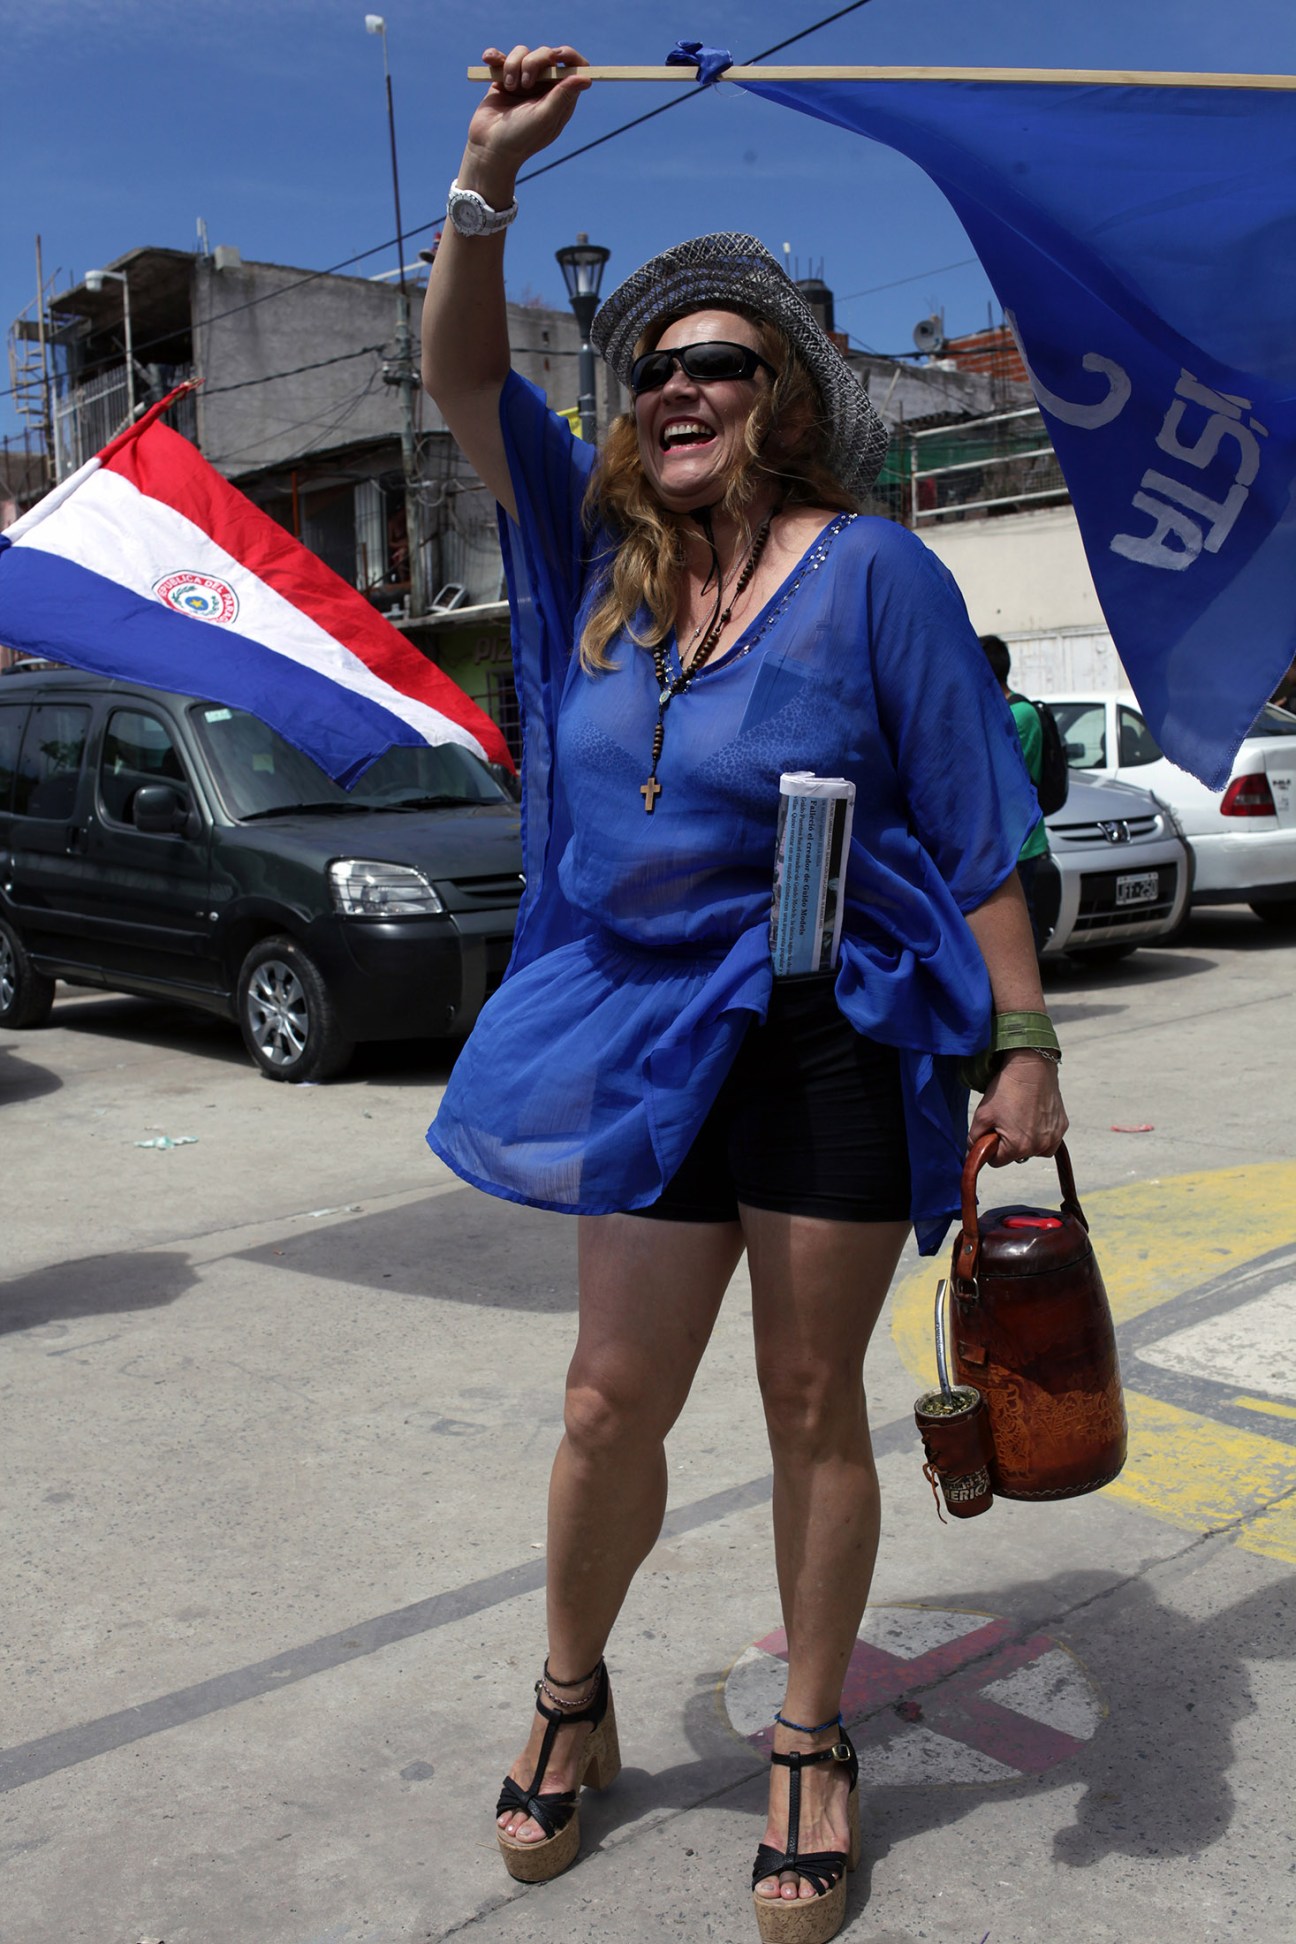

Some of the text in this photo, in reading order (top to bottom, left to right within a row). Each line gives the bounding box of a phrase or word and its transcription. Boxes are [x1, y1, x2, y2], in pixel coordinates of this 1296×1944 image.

[204, 579, 224, 593] DEL
[219, 592, 235, 623] PARAG
[799, 796, 807, 813] Guido
[807, 800, 817, 831] Falleció
[804, 842, 813, 871] creador
[803, 873, 810, 882] de
[801, 884, 809, 907] Guido
[798, 908, 807, 935] Models
[944, 1479, 988, 1501] MERICA
